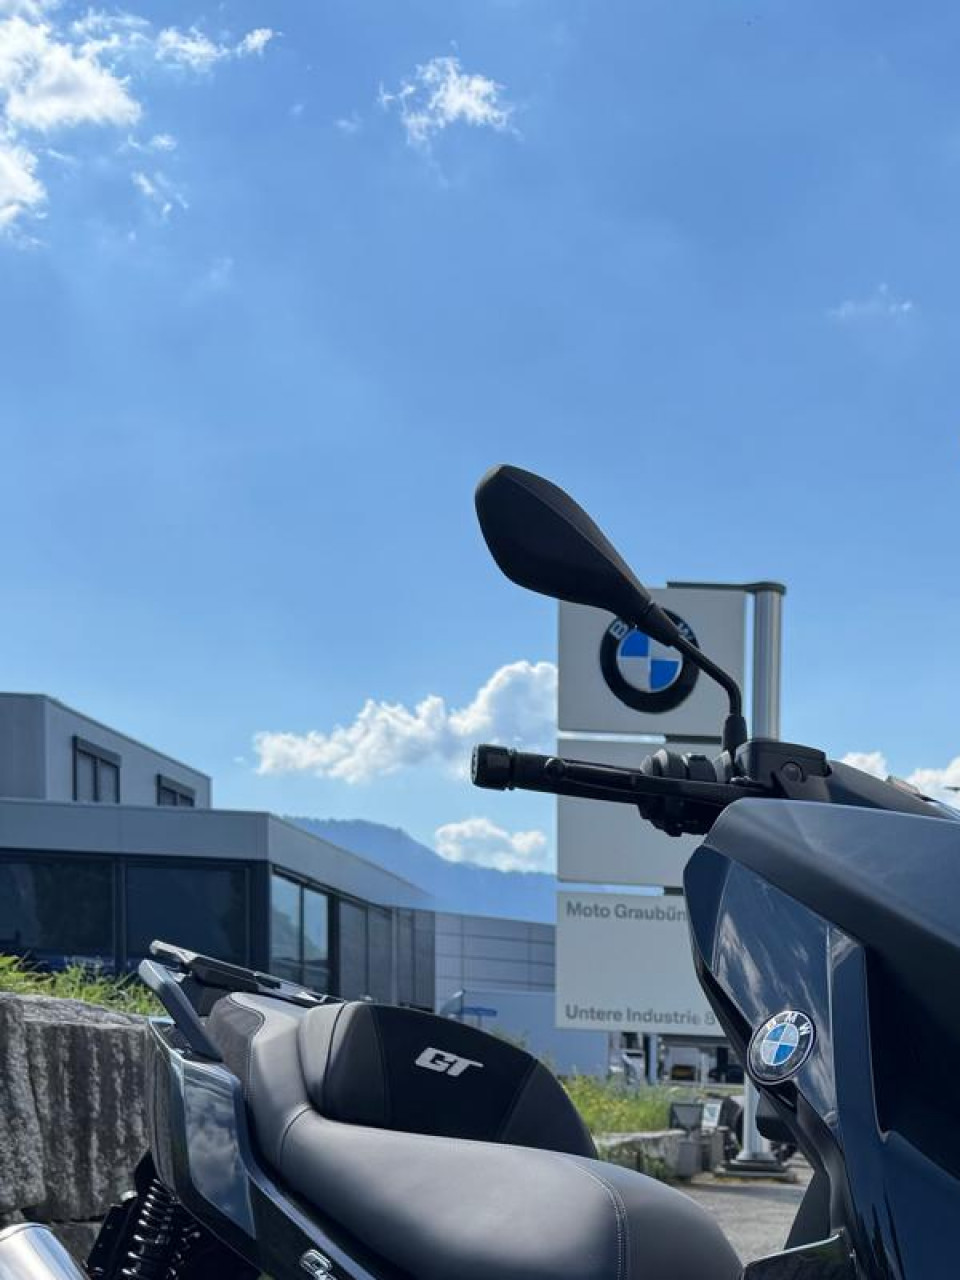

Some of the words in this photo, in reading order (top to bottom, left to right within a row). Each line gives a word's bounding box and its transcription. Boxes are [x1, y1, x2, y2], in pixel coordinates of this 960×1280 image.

[566, 901, 611, 919] Moto
[565, 1004, 623, 1023] Untere
[626, 1007, 700, 1027] Industrie
[415, 1047, 484, 1077] GT
